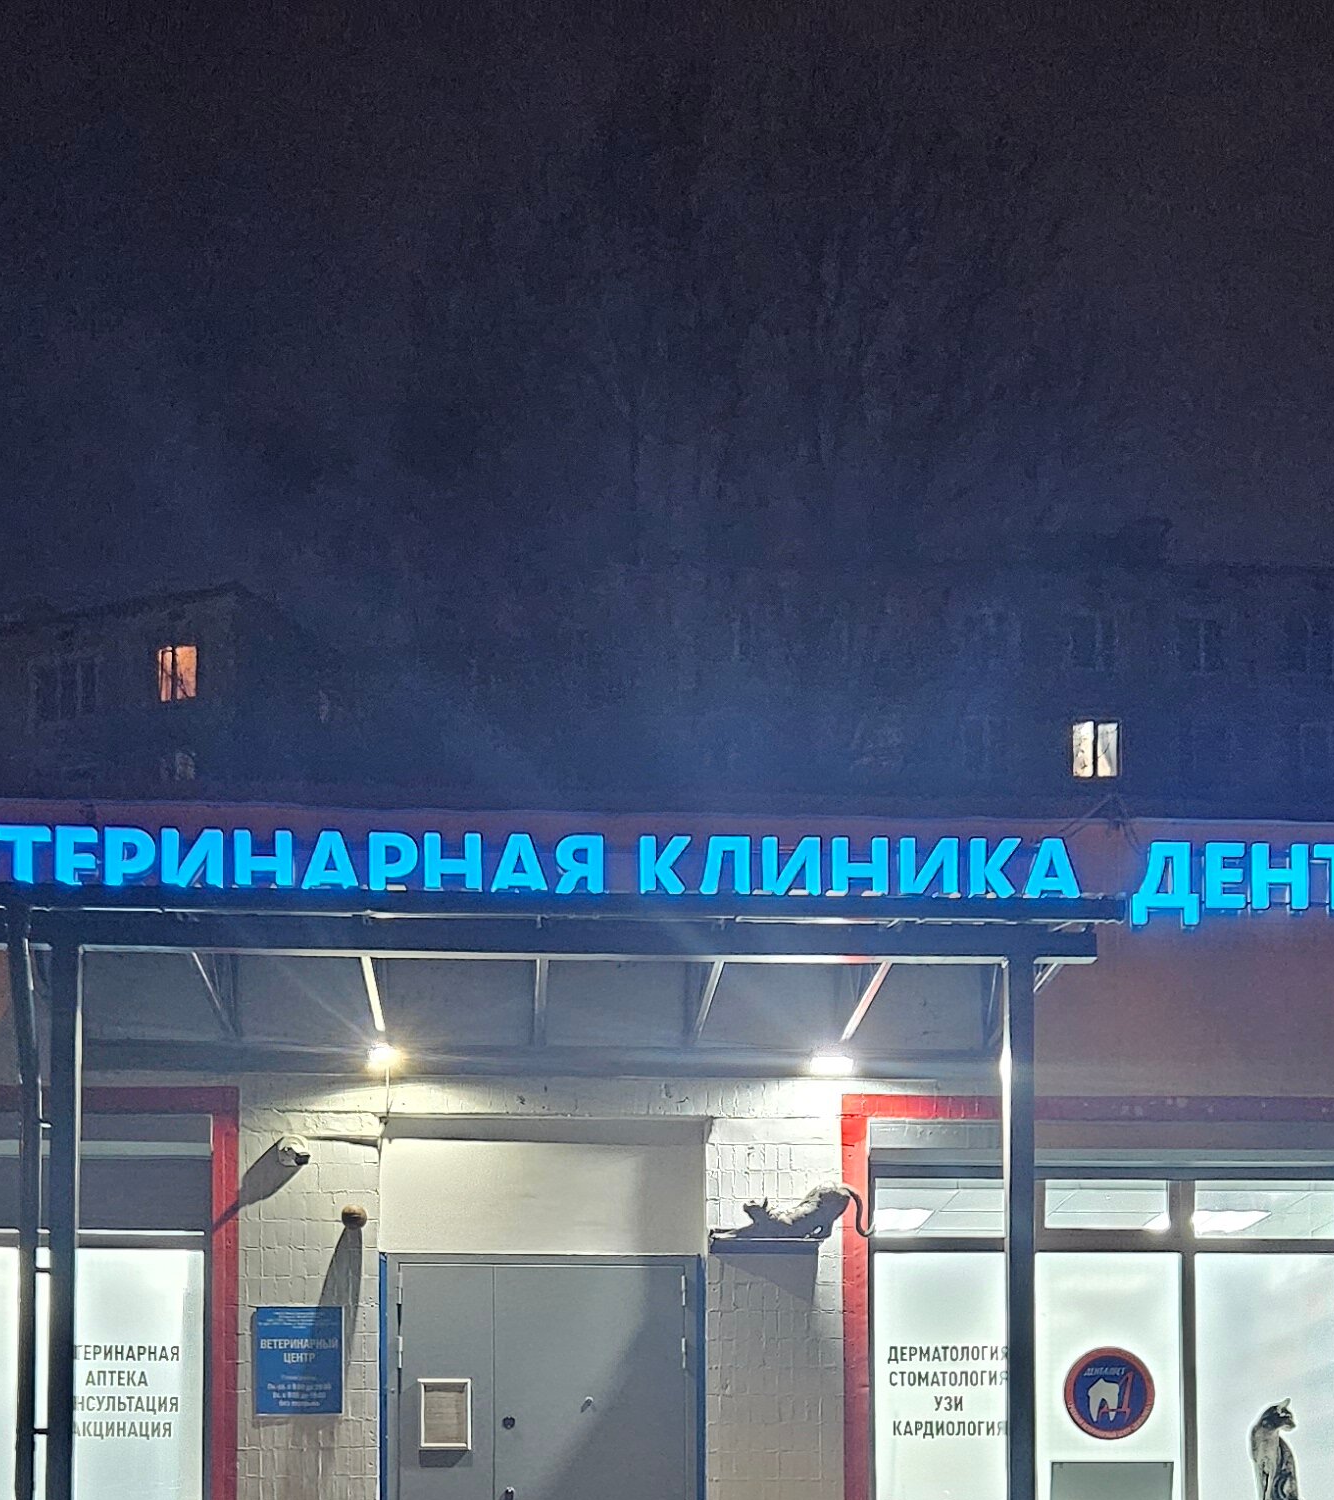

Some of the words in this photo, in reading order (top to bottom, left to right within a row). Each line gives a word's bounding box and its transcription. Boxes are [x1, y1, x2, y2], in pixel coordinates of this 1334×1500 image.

[639, 835, 1080, 898] КЛИНИКА
[260, 1337, 339, 1350] ВЕТЕРИНАРНЫЙ
[74, 1344, 180, 1361] ТЕРИНАРНАЯ
[283, 1352, 316, 1364] ЦЕНТР
[887, 1345, 1008, 1364] ДЕРМАТОЛОГИЯ
[85, 1370, 148, 1387] АПТЕКА
[889, 1370, 1008, 1387] СТОМАТОЛОГИЯ
[74, 1395, 179, 1415] НСУЛЬТАЦИЯ
[934, 1395, 963, 1411] УЗИ
[74, 1421, 172, 1440] АКЦИНАЦИЯ
[892, 1420, 1008, 1439] КАРДИОЛОГИЯ
